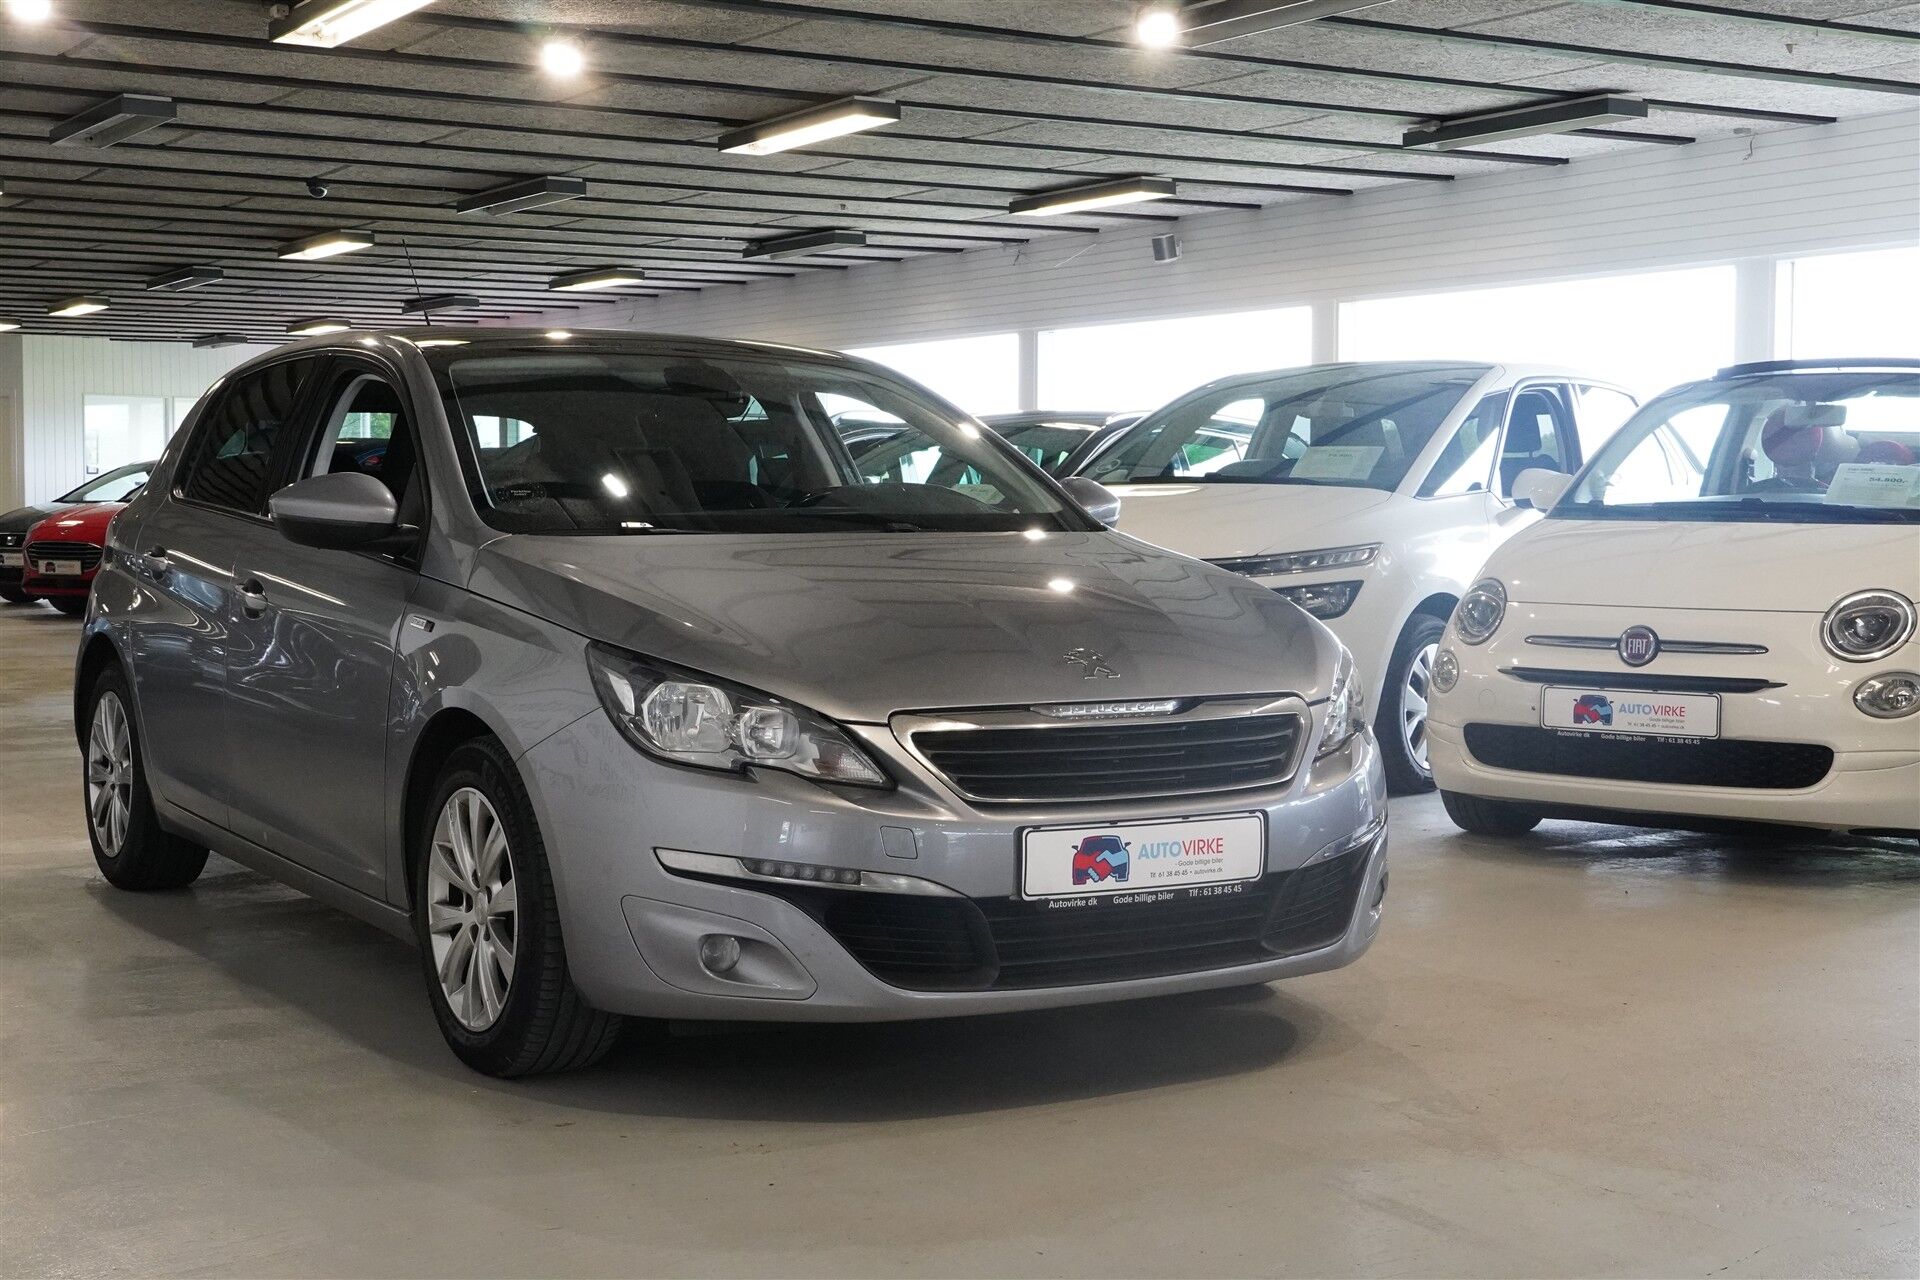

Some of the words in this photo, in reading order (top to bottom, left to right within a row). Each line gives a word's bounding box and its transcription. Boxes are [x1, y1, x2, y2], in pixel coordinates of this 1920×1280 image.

[1628, 638, 1648, 653] FIAT
[1619, 703, 1686, 717] AUTOVIRKE
[1138, 837, 1223, 860] AUTOVIRKE
[1048, 898, 1086, 909] Autovirke
[1113, 895, 1133, 904] Gode
[1134, 893, 1156, 904] billige
[1157, 892, 1174, 901] biler
[1203, 887, 1212, 895] 61
[1213, 887, 1222, 895] 38
[1223, 886, 1232, 894] 45
[1233, 885, 1242, 893] 45
